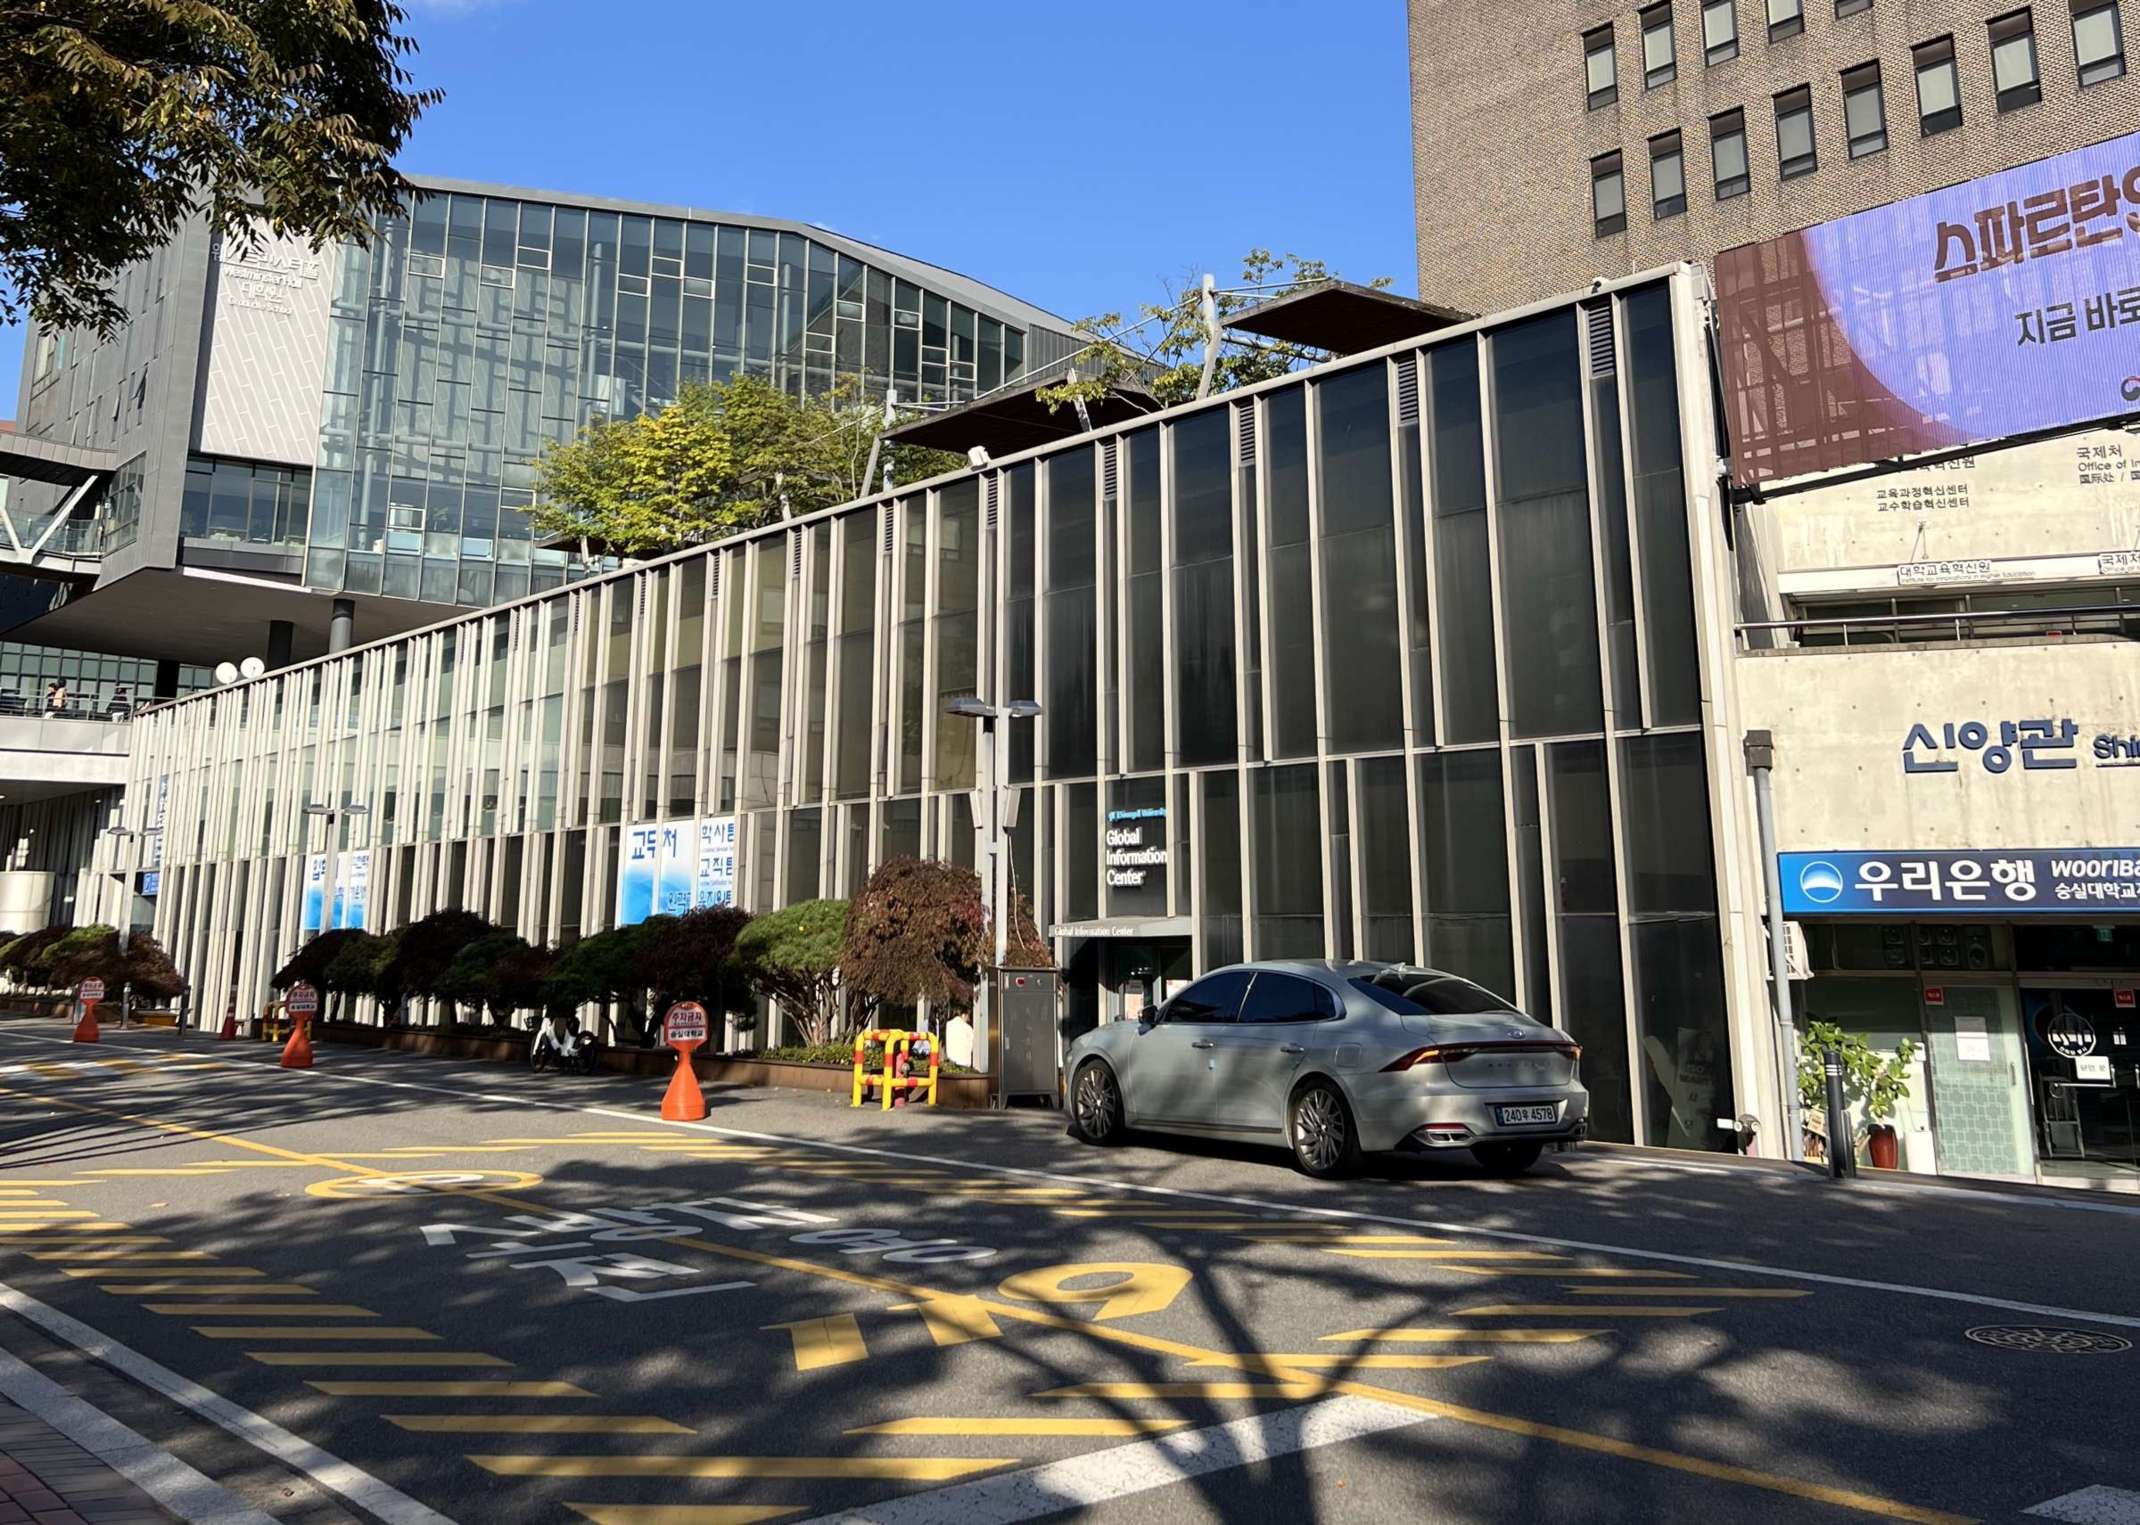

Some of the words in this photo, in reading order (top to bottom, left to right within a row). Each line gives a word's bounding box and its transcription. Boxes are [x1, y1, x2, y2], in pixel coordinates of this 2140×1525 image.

[2014, 302, 2077, 346] 지금
[2076, 444, 2122, 460] 국제처
[2078, 461, 2112, 472] Office
[2116, 459, 2127, 470] of
[1903, 718, 2079, 774] 신양관
[1106, 827, 1142, 847] Global
[1106, 846, 1167, 866] Information
[1106, 869, 1145, 887] Center
[1854, 859, 2036, 902] 우리은행
[1055, 926, 1074, 937] Global
[1075, 925, 1110, 937] Information
[1112, 926, 1136, 936] Center
[1531, 1107, 1554, 1121] 4578
[758, 1262, 1195, 1371] 119
